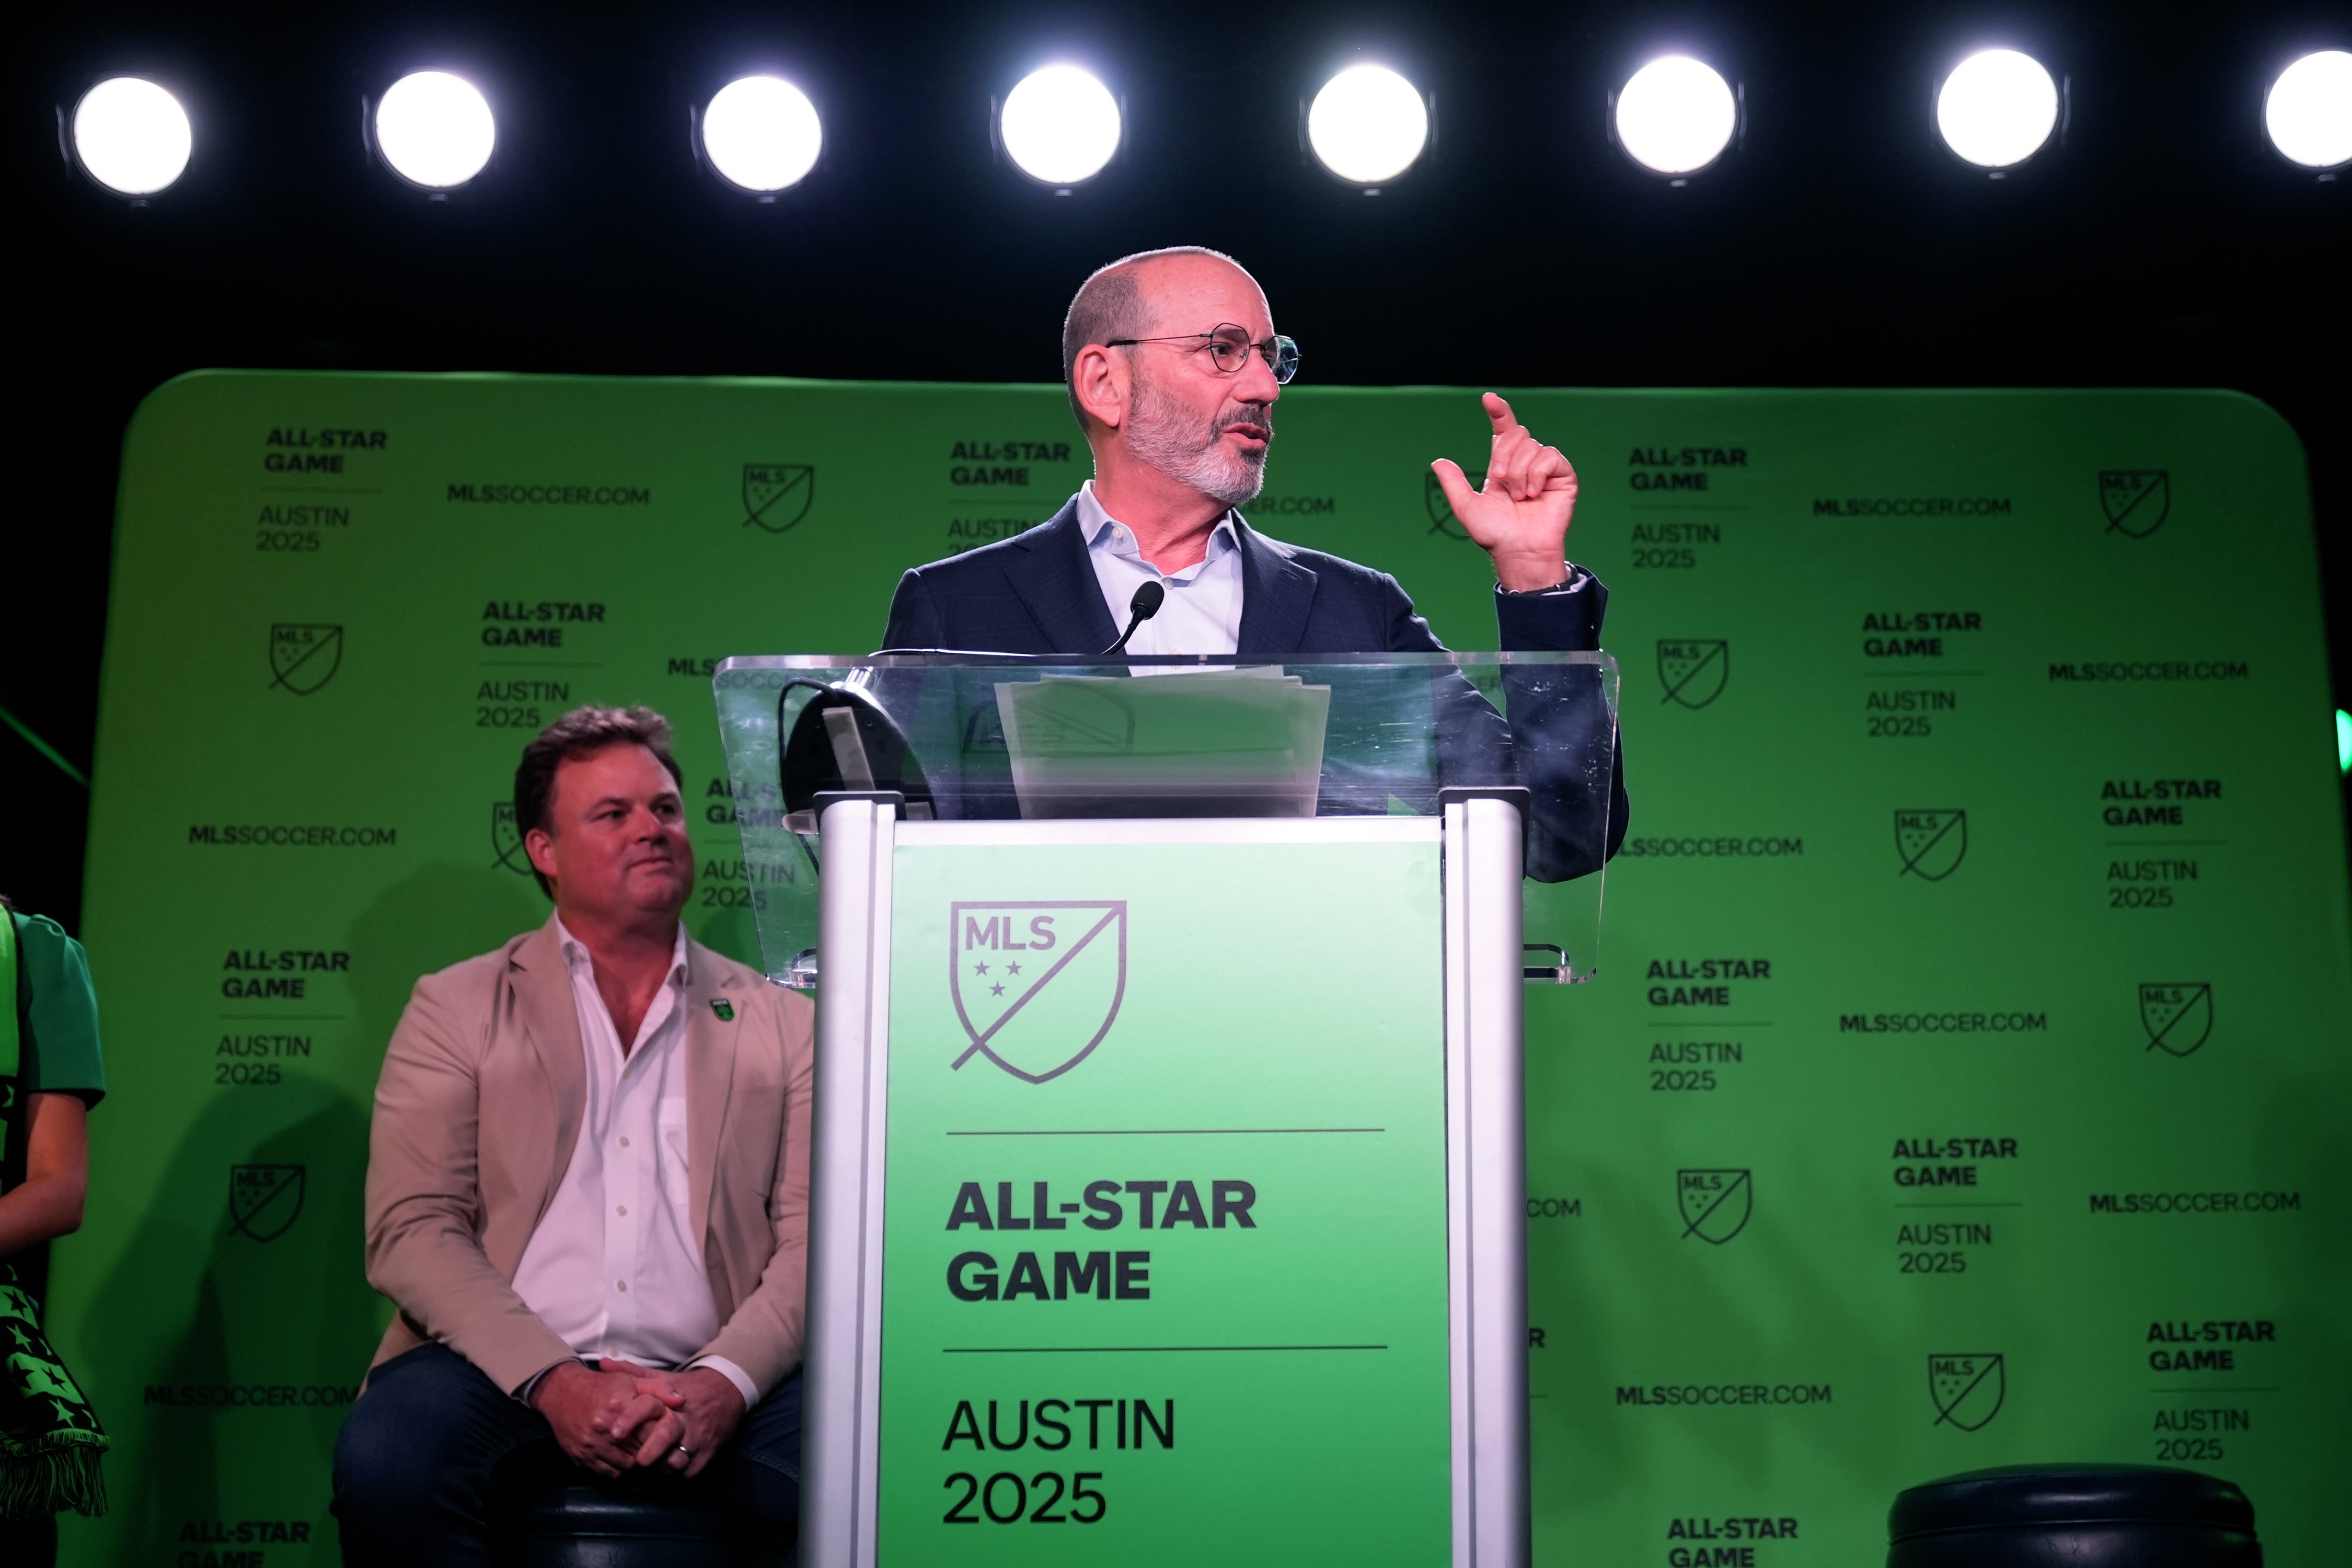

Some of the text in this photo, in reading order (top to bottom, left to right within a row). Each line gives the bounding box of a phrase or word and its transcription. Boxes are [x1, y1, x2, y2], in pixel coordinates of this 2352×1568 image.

[267, 428, 387, 449] ALL-STAR
[951, 441, 1070, 462] ALL-STAR
[1629, 447, 1748, 467] ALL-STAR
[264, 453, 343, 473] GAME
[750, 471, 785, 484] MLS
[950, 466, 1029, 486] GAME
[1630, 472, 1707, 491] GAME
[2106, 478, 2141, 491] MLS
[446, 483, 650, 505] MLSSOCCER.COM
[258, 505, 350, 527] AUSTIN
[1813, 497, 2013, 516] MLSSOCCER.COM
[256, 530, 320, 552] 2025
[1631, 523, 1721, 544] AUSTIN
[1632, 548, 1696, 569] 2025
[482, 601, 605, 622] ALL-STAR
[1863, 612, 1982, 632] ALL-STAR
[276, 631, 314, 644] MLS
[481, 627, 561, 647] GAME
[1864, 638, 1942, 656] GAME
[1664, 647, 1699, 660] MLS
[2049, 661, 2249, 681] MLSSOCCER.COM
[477, 681, 569, 702] AUSTIN
[1866, 690, 1956, 711] AUSTIN
[476, 706, 540, 728] 2025
[1868, 716, 1932, 737] 2025
[2102, 779, 2222, 800] ALL-STAR
[1900, 817, 1938, 830] MLS
[2103, 805, 2183, 826] GAME
[188, 824, 396, 846] MLSSOCCER.COM
[2107, 859, 2198, 882] AUSTIN
[702, 886, 766, 910] 2025
[2109, 886, 2174, 908] 2025
[965, 915, 1056, 951] MLS
[223, 950, 351, 972] ALL-STAR
[1646, 959, 1771, 979] ALL-STAR
[222, 977, 305, 998] GAME
[1647, 986, 1730, 1007] GAME
[2146, 990, 2183, 1004] MLS
[1840, 1012, 2048, 1033] MLSSOCCER.COM
[216, 1035, 312, 1057] AUSTIN
[1649, 1042, 1743, 1064] AUSTIN
[215, 1063, 281, 1085] 2025
[1650, 1069, 1716, 1091] 2025
[1893, 1137, 2018, 1159] ALL-STAR
[237, 1171, 275, 1187] MLS
[1684, 1175, 1722, 1190] MLS
[1894, 1166, 1977, 1186] GAME
[945, 1180, 1256, 1231] ALL-STAR
[2090, 1192, 2300, 1213] MLSSOCCER.COM
[1897, 1224, 1992, 1246] AUSTIN
[1899, 1251, 1967, 1274] 2025
[947, 1251, 1150, 1302] GAME
[2148, 1320, 2277, 1343] ALL-STAR
[1935, 1361, 1974, 1376] MLS
[2150, 1350, 2234, 1371] GAME
[1616, 1385, 1831, 1405] MLSSOCCER.COM
[941, 1399, 1174, 1451] AUSTIN
[2154, 1408, 2250, 1432] AUSTIN
[2157, 1438, 2224, 1461] 2025
[943, 1471, 1106, 1525] 2025
[178, 1520, 310, 1543] ALL-STAR
[1667, 1517, 1798, 1540] ALL-STAR
[177, 1550, 264, 1568] GAME
[1669, 1547, 1755, 1568] GAME
